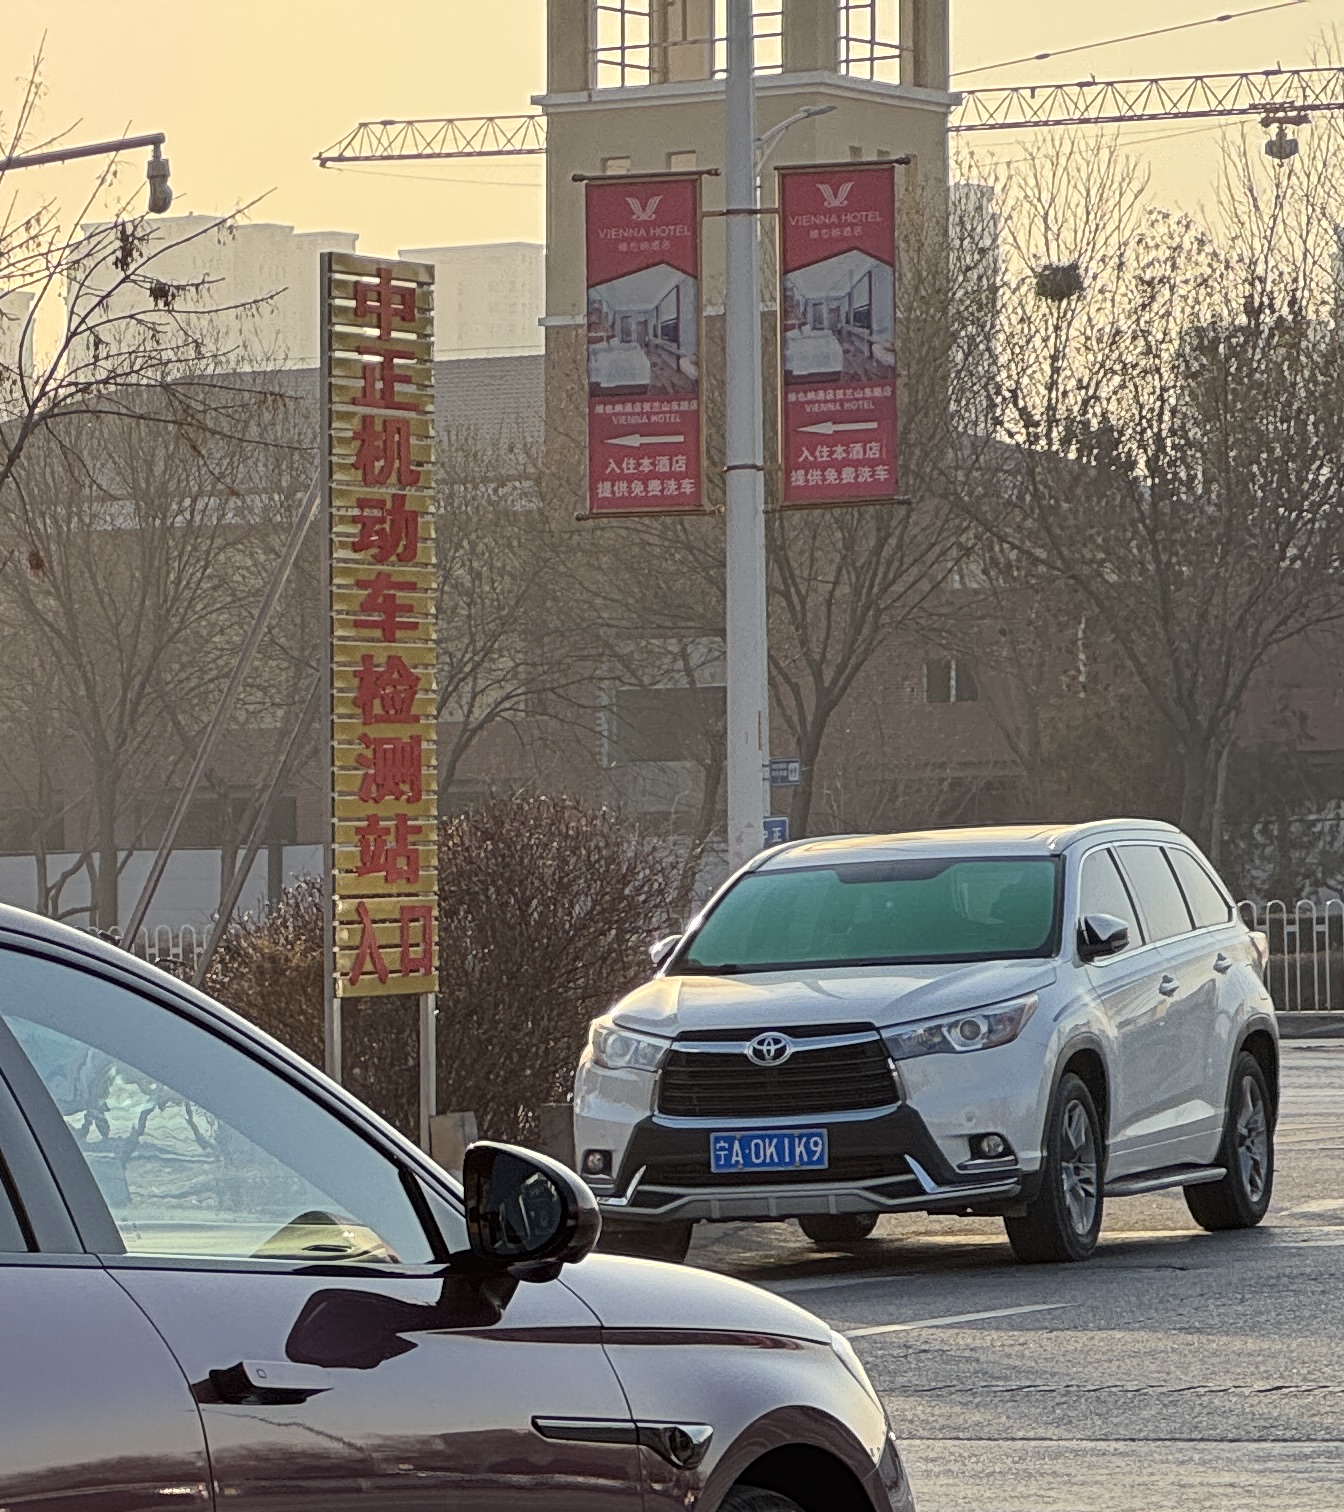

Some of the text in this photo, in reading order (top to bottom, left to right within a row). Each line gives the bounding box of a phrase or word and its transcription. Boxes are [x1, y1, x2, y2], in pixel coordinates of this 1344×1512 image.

[788, 210, 883, 227] VIENNA HOTEL
[597, 224, 692, 240] VIENNA HOTEL
[844, 399, 876, 411] HOTEL
[798, 441, 882, 462] 入住本酒店
[605, 454, 687, 475] 入住本酒店
[790, 464, 891, 487] 提供免费洗车
[596, 478, 696, 498] 提供免费洗车
[352, 266, 423, 884] 中正机动车检测站
[348, 900, 433, 986] 入口
